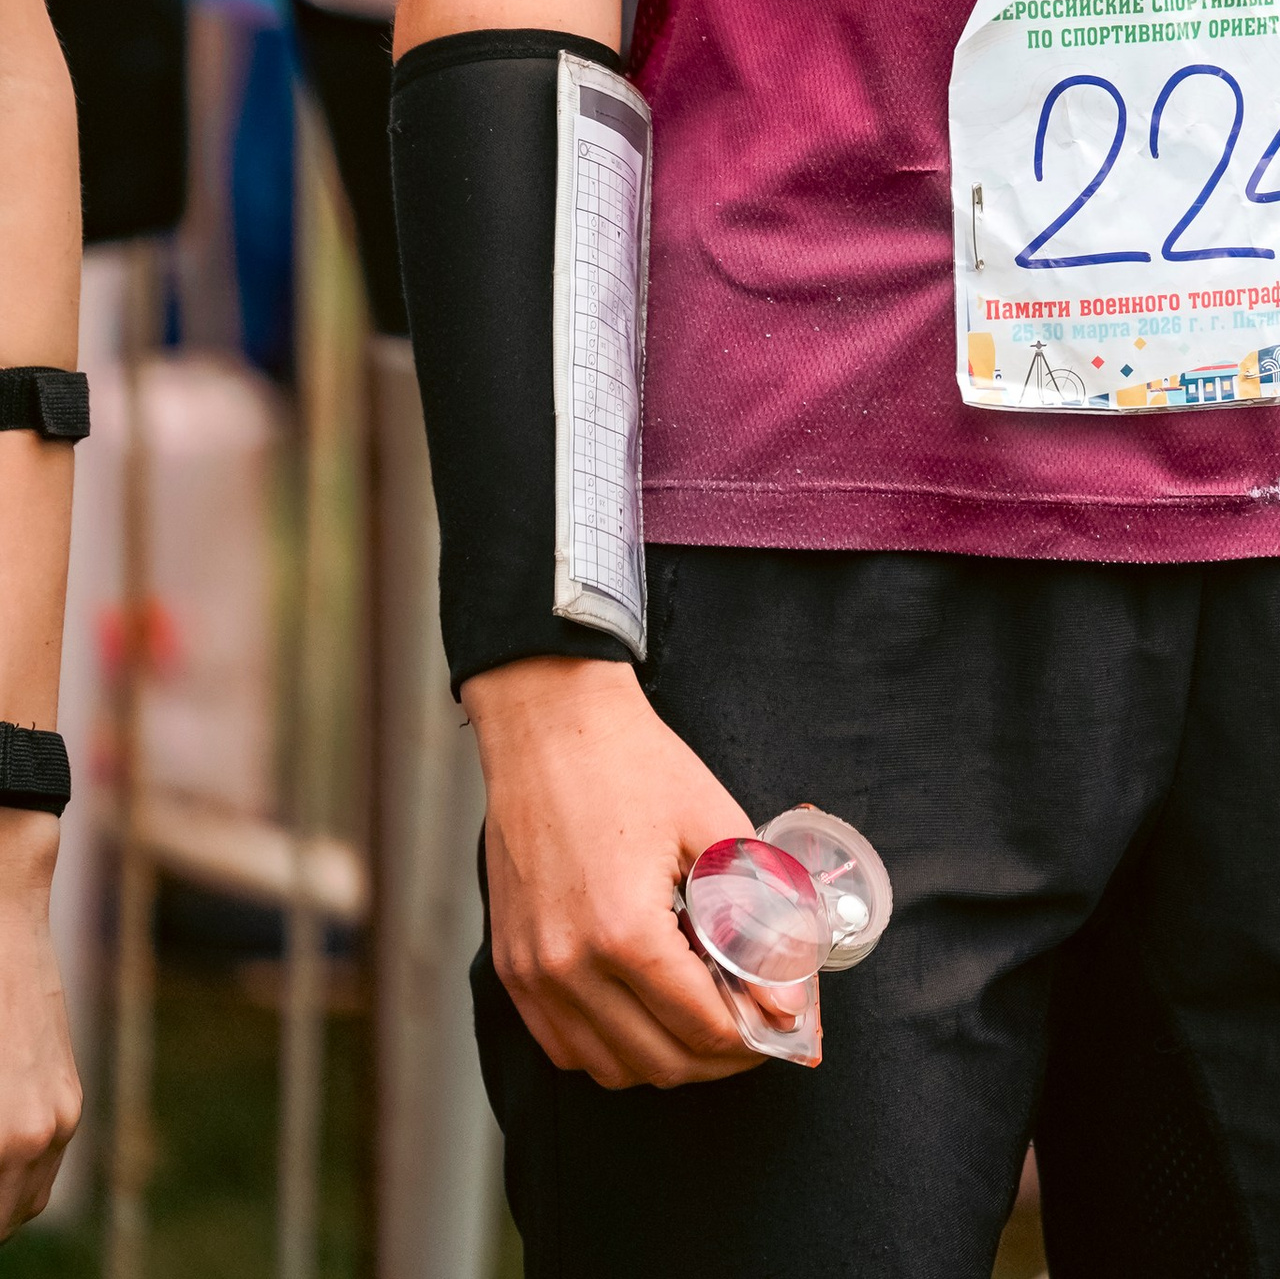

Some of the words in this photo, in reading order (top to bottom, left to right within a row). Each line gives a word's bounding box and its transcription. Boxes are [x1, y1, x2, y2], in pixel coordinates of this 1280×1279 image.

[1027, 30, 1052, 49] ПО
[1061, 21, 1201, 48] СПОРТИВНОМУ
[986, 299, 1070, 321] Памяти
[1079, 293, 1180, 317] военного
[1012, 322, 1064, 343] 25-30
[1072, 321, 1130, 343] марта
[1138, 316, 1181, 337] 2026
